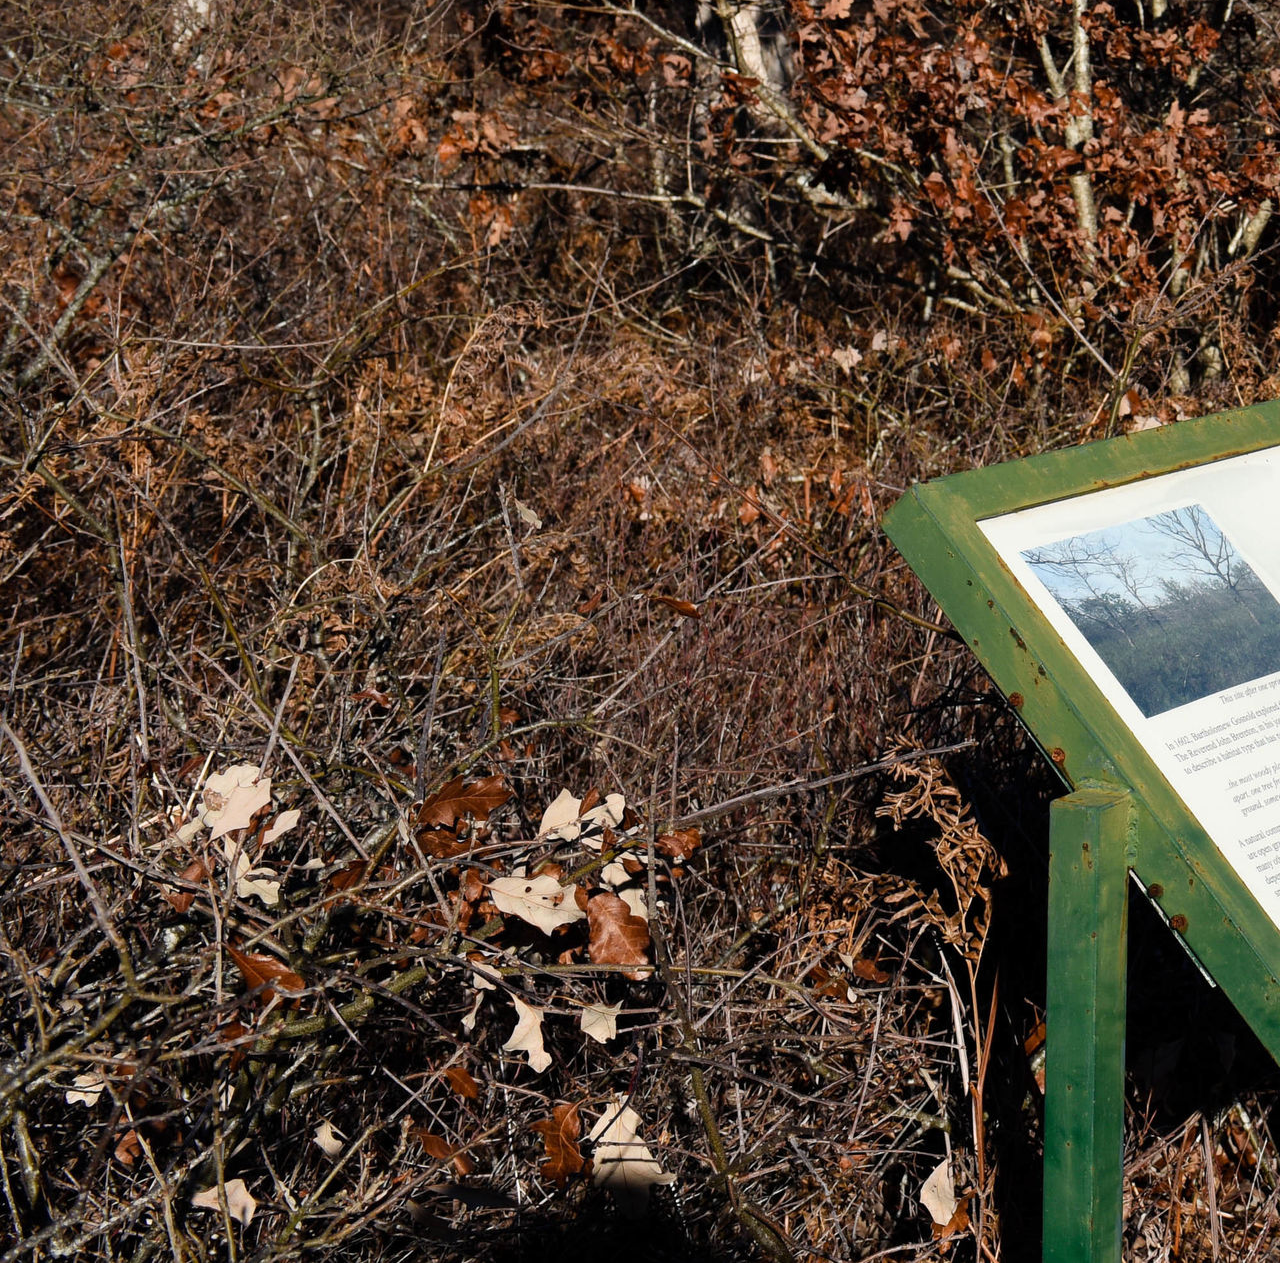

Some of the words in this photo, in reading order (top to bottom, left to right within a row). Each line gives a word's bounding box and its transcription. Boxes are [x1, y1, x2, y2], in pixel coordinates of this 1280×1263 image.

[1220, 696, 1233, 704] This
[1246, 688, 1256, 696] after
[1191, 723, 1230, 740] Bartholomew
[1256, 704, 1280, 717] explored
[1174, 754, 1189, 762] The
[1187, 742, 1217, 757] Reverend
[1216, 737, 1232, 746] John
[1263, 720, 1274, 729] his
[1192, 758, 1217, 771] describe
[1220, 748, 1242, 760] habitat
[1241, 744, 1255, 754] type
[1254, 739, 1267, 747] that
[1245, 830, 1266, 845] natural
[1248, 852, 1258, 860] are
[1258, 846, 1272, 856] open
